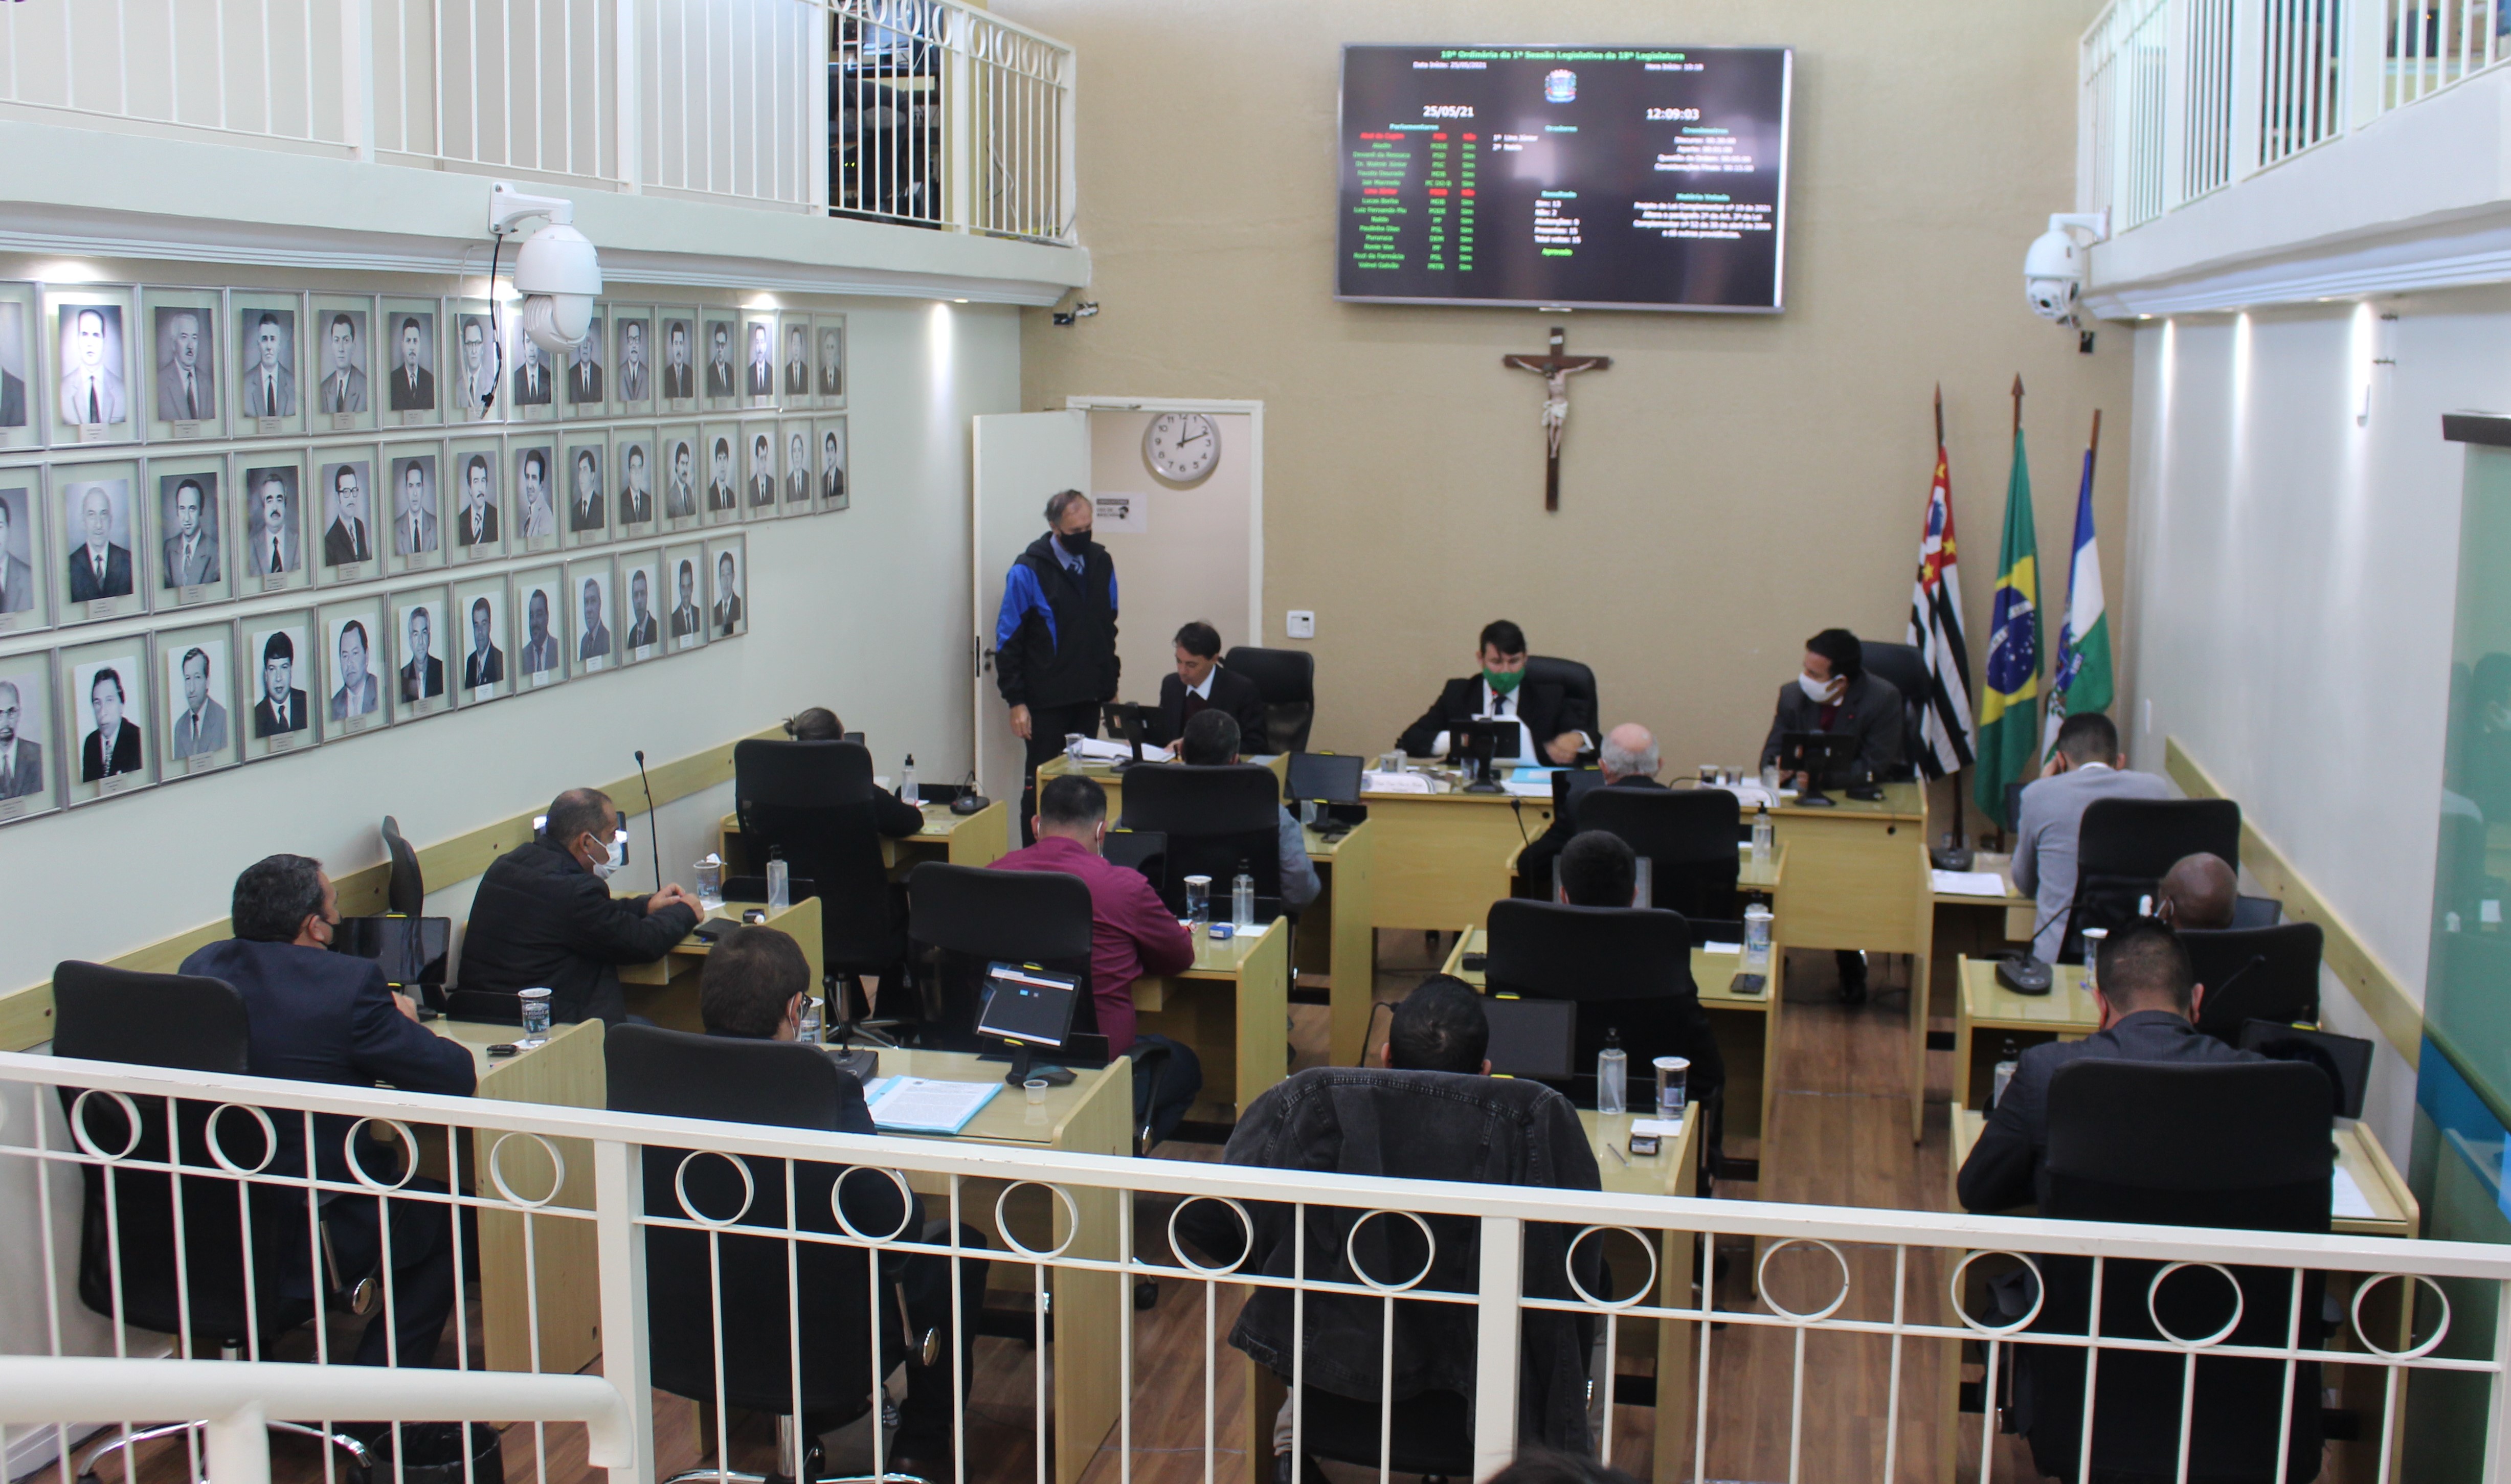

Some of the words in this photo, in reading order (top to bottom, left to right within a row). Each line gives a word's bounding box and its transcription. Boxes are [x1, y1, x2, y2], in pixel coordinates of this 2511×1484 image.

[1458, 50, 1498, 59] Ordinária
[1499, 51, 1512, 59] da
[1524, 51, 1556, 60] Sessão
[1556, 51, 1604, 61] Legislativa
[1604, 52, 1617, 60] da
[1635, 52, 1685, 61] Legislatura
[1423, 105, 1474, 119] 25/05/21
[1646, 108, 1700, 121] 12:09:03
[1461, 188, 1475, 196] Não
[1541, 190, 1577, 199] Resultado
[1633, 201, 1658, 210] Projeto
[1658, 202, 1667, 211] de
[1667, 202, 1678, 211] Lei
[1678, 202, 1724, 212] Complementar
[1745, 204, 1754, 212] de
[1633, 219, 1680, 229] Complementar
[1699, 221, 1709, 229] de
[1719, 221, 1728, 230] de
[1744, 222, 1754, 230] de
[1541, 248, 1573, 257] Aprovado
